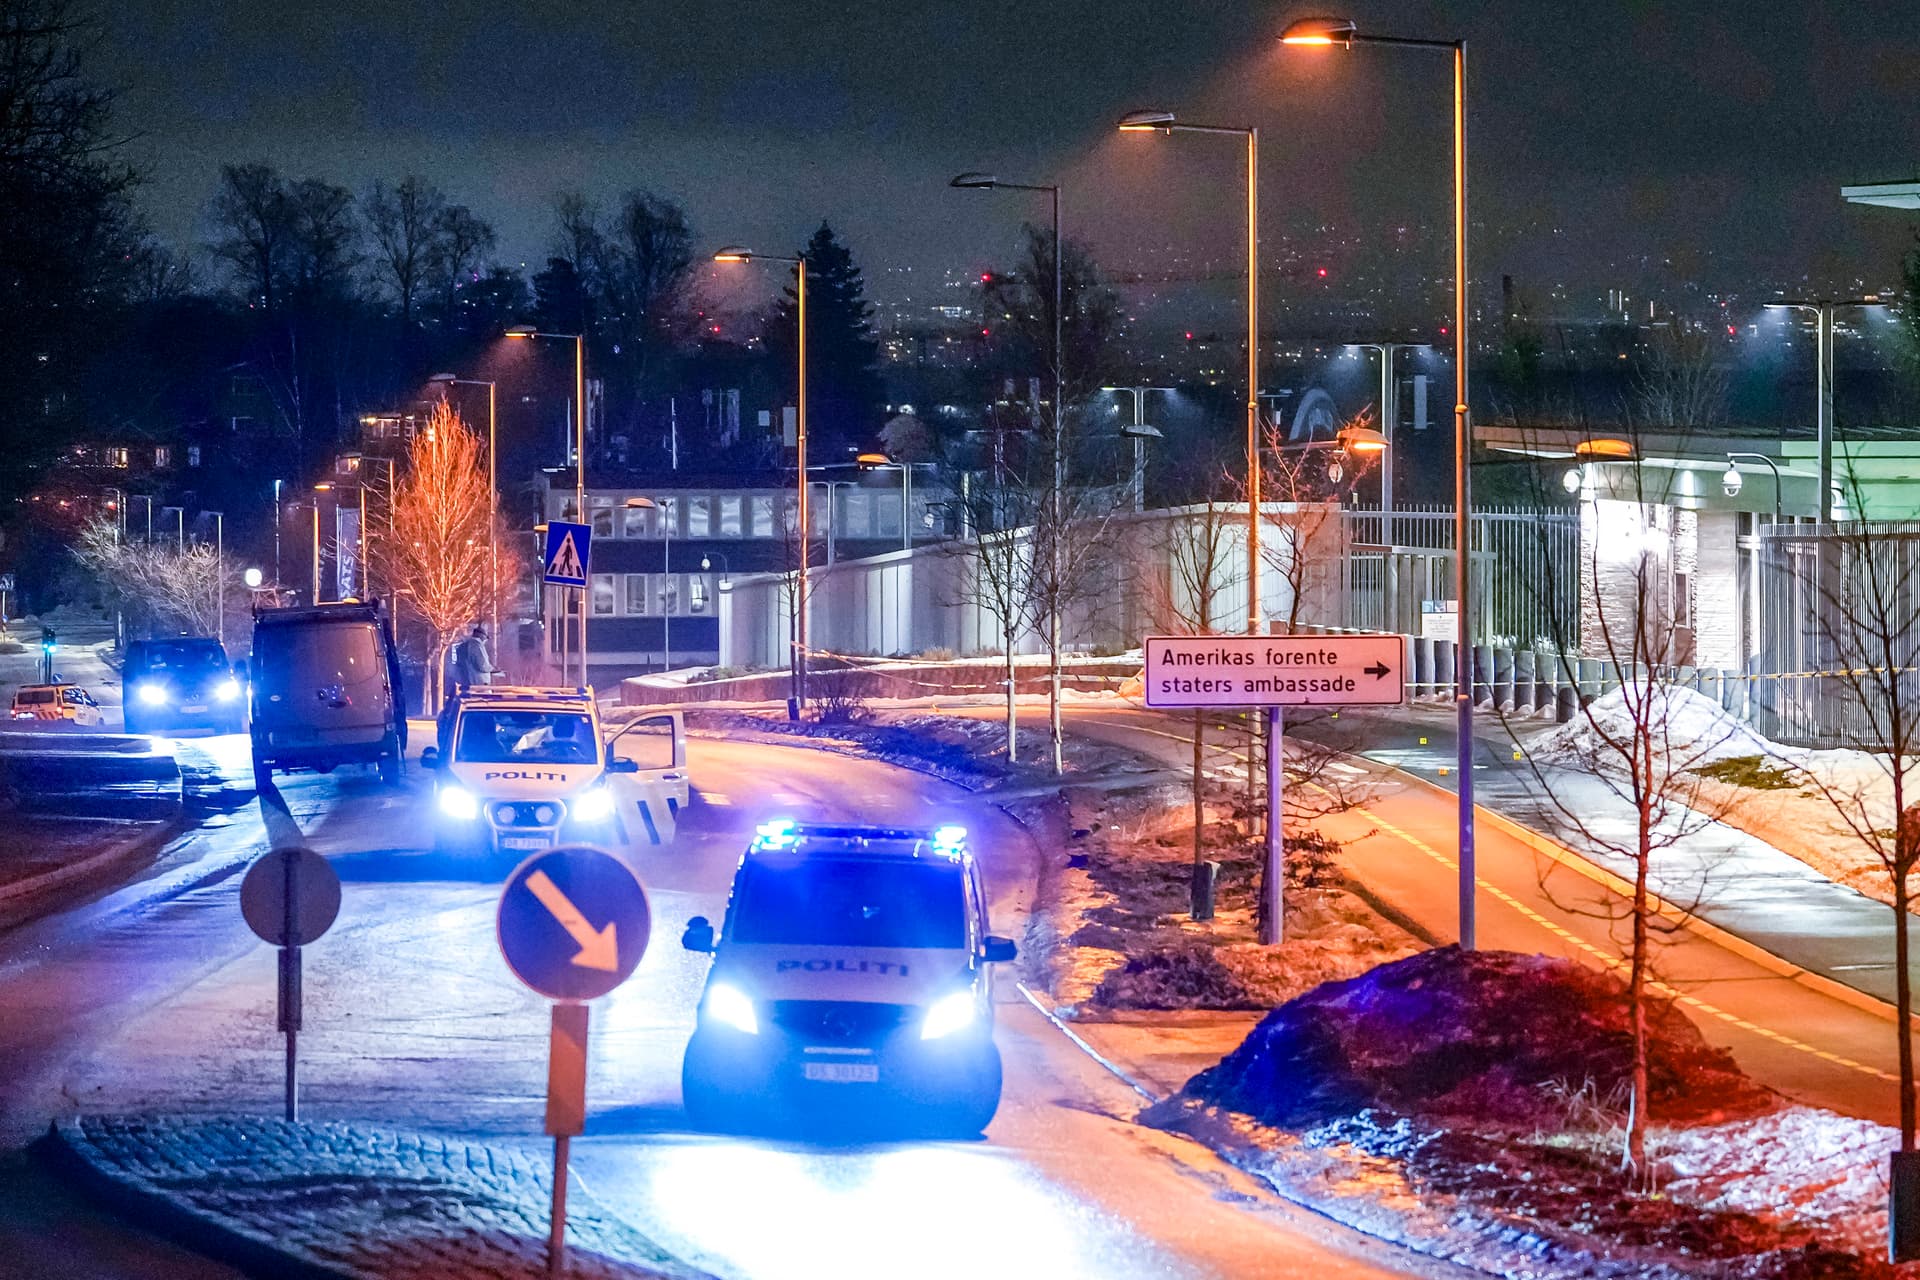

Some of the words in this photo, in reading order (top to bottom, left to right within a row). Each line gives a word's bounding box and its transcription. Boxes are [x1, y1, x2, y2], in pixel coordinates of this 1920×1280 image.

[340, 555, 354, 598] SATS
[1162, 648, 1255, 666] Amerikas
[1266, 648, 1338, 665] forente
[1162, 676, 1233, 693] staters
[1244, 675, 1356, 692] ambassade
[485, 771, 566, 782] POLITI
[776, 959, 908, 976] POLITI
